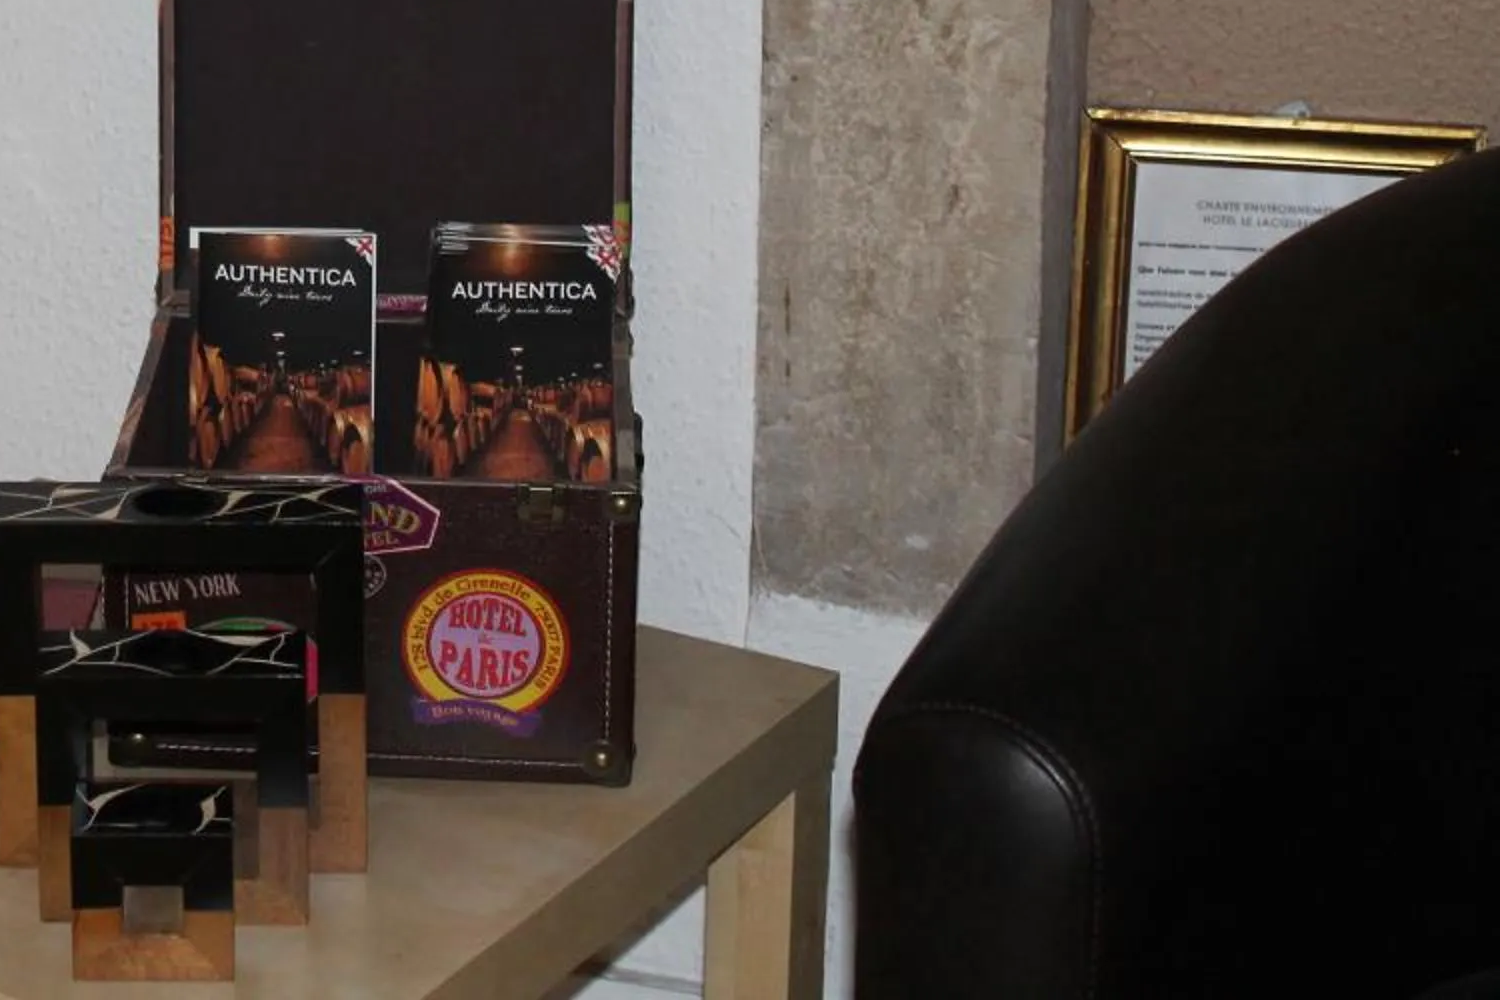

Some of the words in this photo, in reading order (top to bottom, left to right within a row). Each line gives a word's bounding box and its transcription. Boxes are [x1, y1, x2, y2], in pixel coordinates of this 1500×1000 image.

[215, 263, 357, 287] AUTHENTICA
[451, 281, 597, 300] AUTHENTICA
[367, 501, 421, 534] ND
[133, 578, 180, 606] NEW
[183, 572, 242, 600] YORK
[448, 597, 527, 637] HOTEL
[438, 640, 531, 691] PARIS
